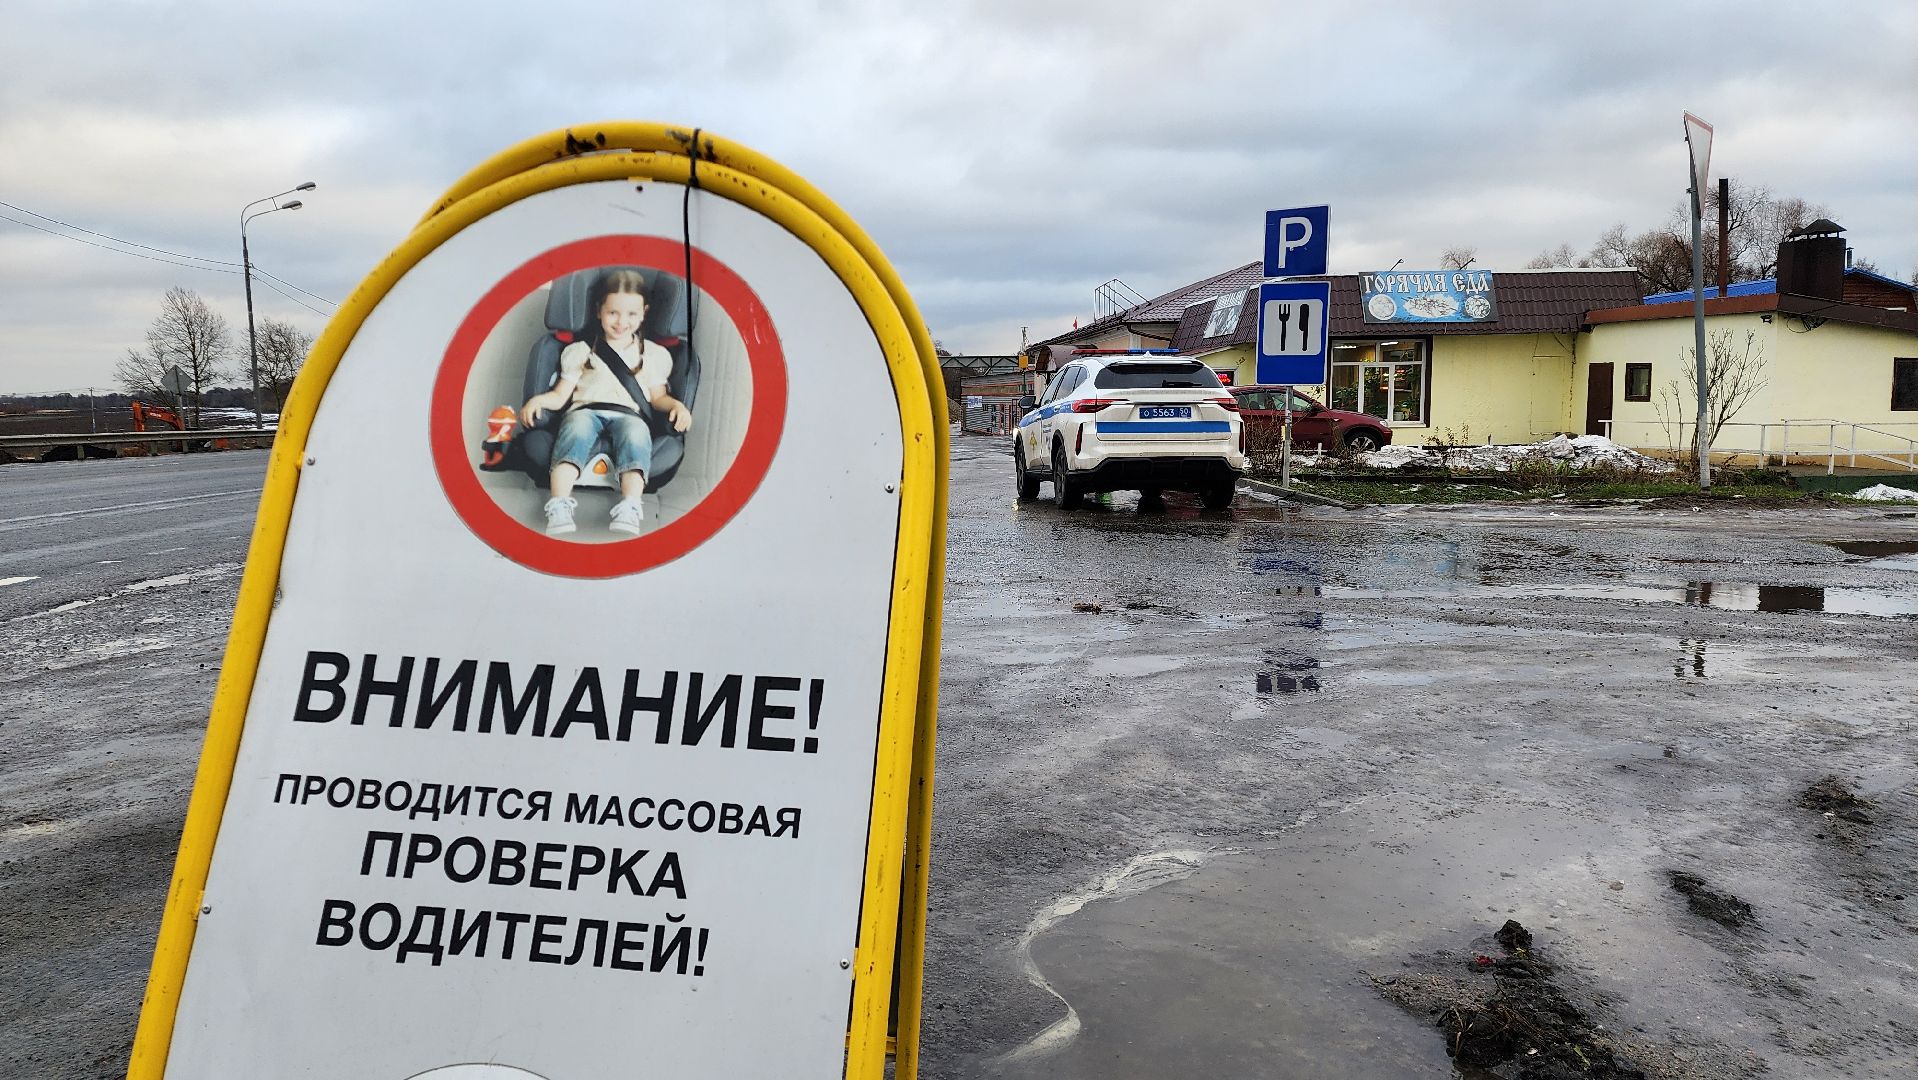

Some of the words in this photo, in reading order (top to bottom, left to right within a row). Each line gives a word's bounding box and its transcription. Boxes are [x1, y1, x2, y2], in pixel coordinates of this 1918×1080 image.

[1278, 216, 1313, 269] P
[1362, 272, 1448, 294] ГОРЯЧАЯ
[1452, 272, 1490, 295] ЕДА
[1152, 408, 1175, 417] 5563
[294, 651, 824, 753] ВНИМАНИЕ!
[274, 774, 552, 821] ПРОВОДИТСЯ
[564, 793, 801, 838] МАССОВАЯ
[360, 831, 686, 899] ПРОВЕРКА
[316, 900, 709, 976] ВОДИТЕЛЕЙ!
